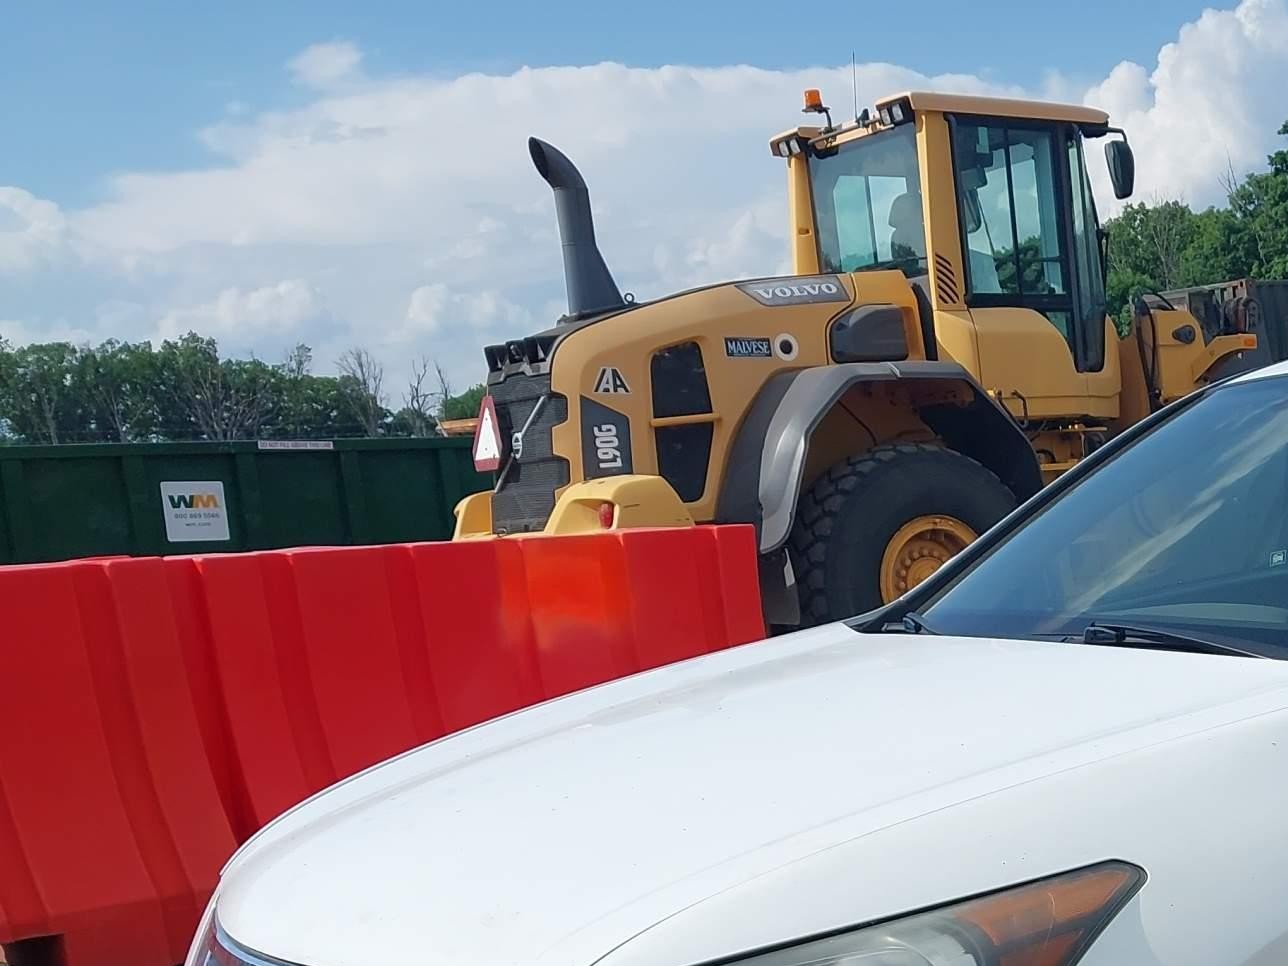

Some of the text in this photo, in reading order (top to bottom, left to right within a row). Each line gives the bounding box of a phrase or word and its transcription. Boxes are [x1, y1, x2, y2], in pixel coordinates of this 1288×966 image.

[754, 283, 838, 299] VOLVO
[727, 340, 770, 354] MALVESE
[593, 424, 622, 469] L90G
[167, 494, 218, 509] WM
